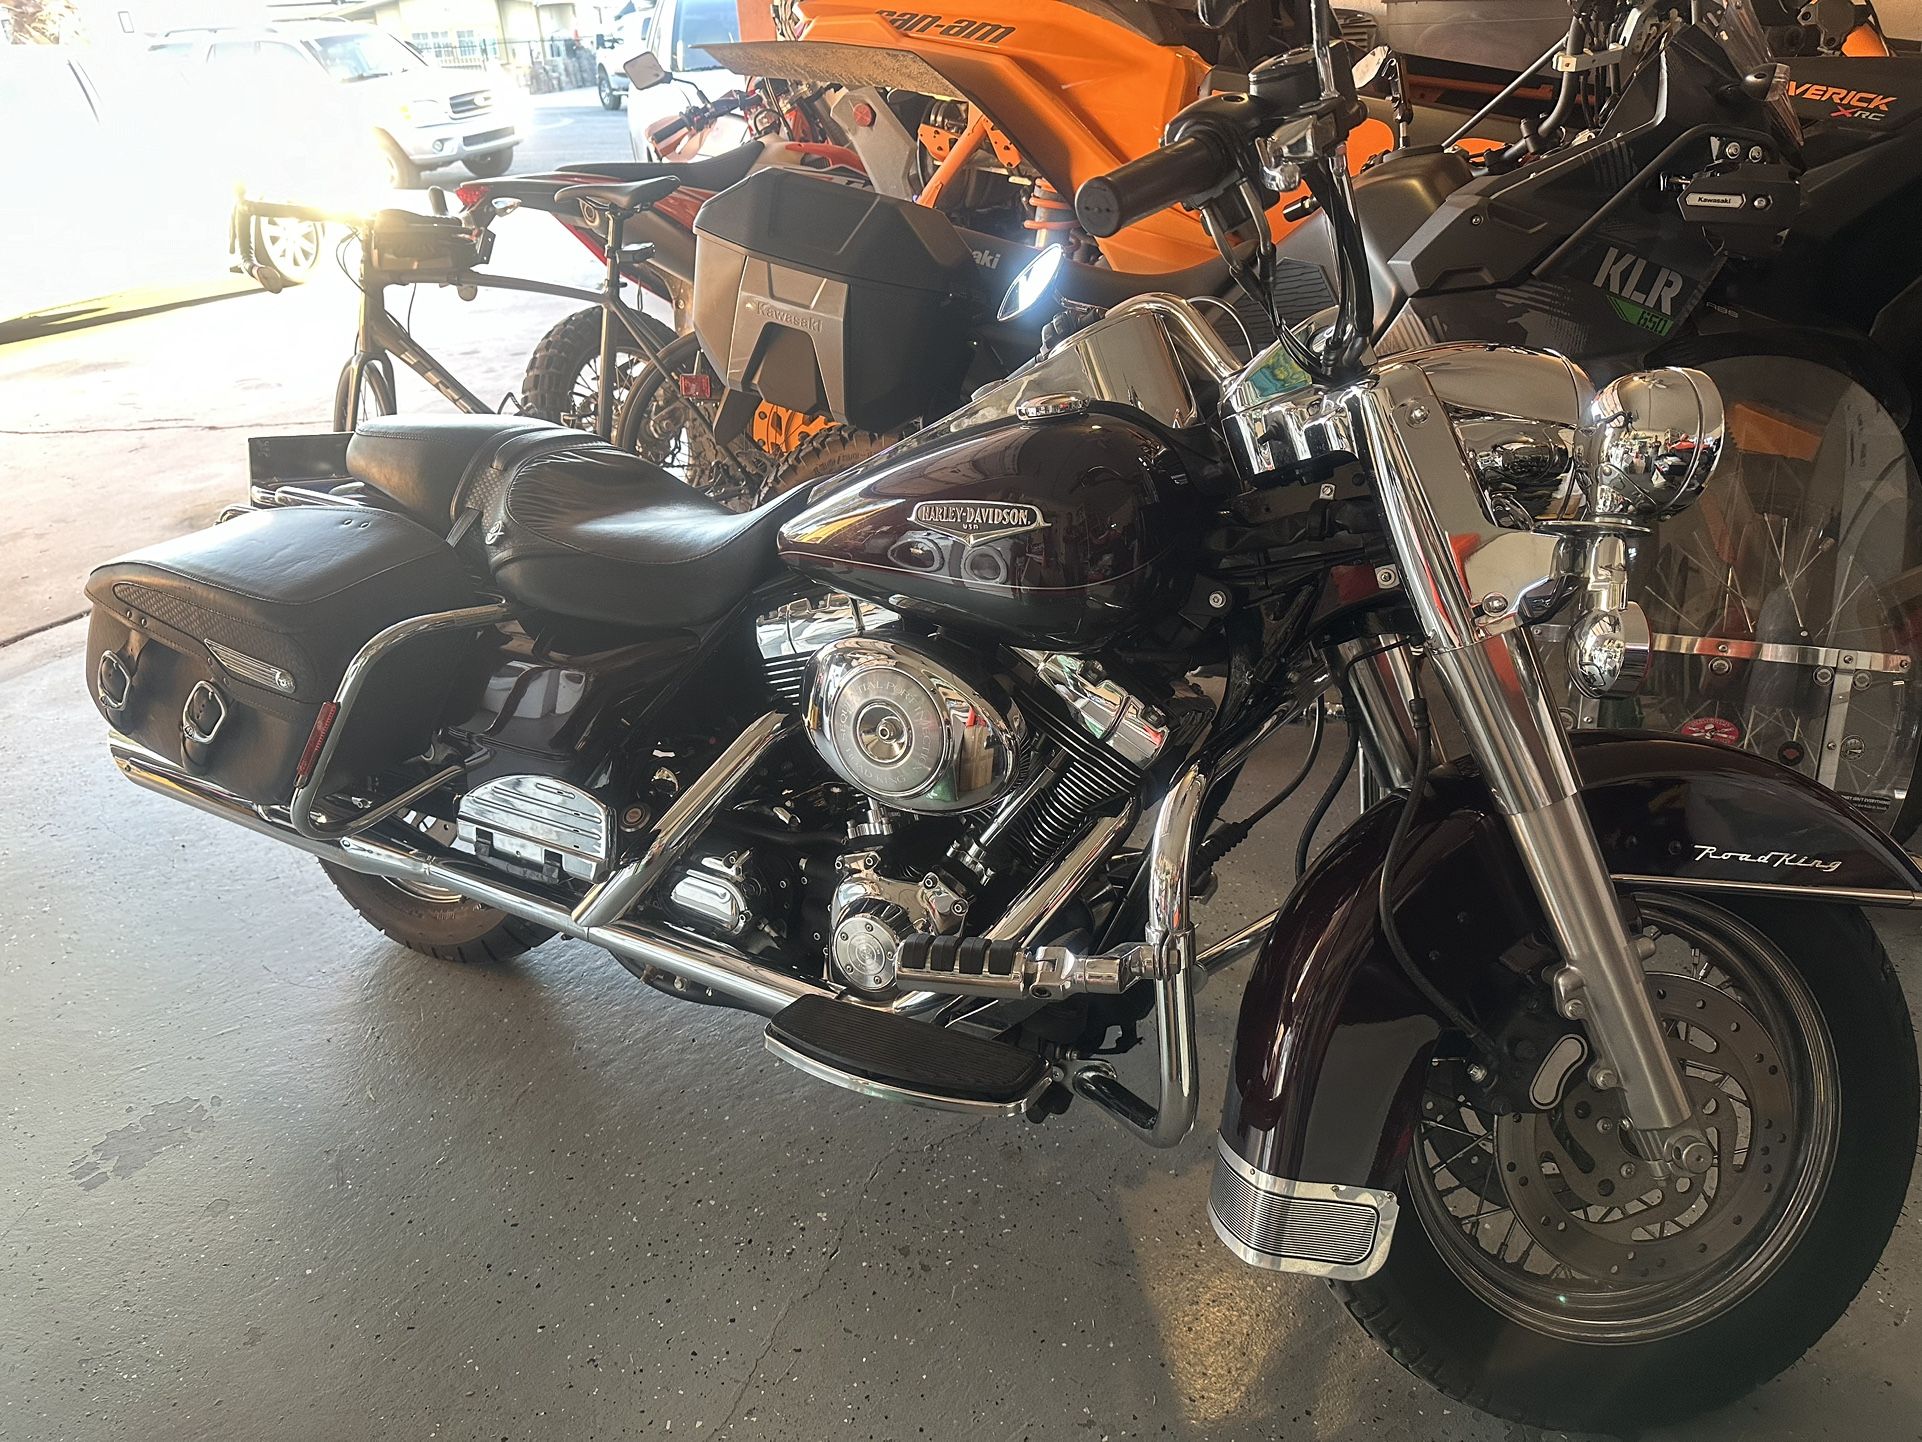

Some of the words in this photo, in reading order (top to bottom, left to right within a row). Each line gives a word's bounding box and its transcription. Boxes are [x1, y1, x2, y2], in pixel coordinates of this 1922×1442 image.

[1786, 80, 1898, 111] VERICK
[1697, 196, 1732, 204] Kawasaki
[1592, 246, 1683, 315] KLR
[756, 300, 823, 333] Kawasaki
[1637, 310, 1668, 334] 650
[840, 680, 883, 742] SEQUTIAL
[886, 681, 916, 704] PORT
[1694, 844, 1772, 864] Road
[1771, 851, 1842, 873] King
